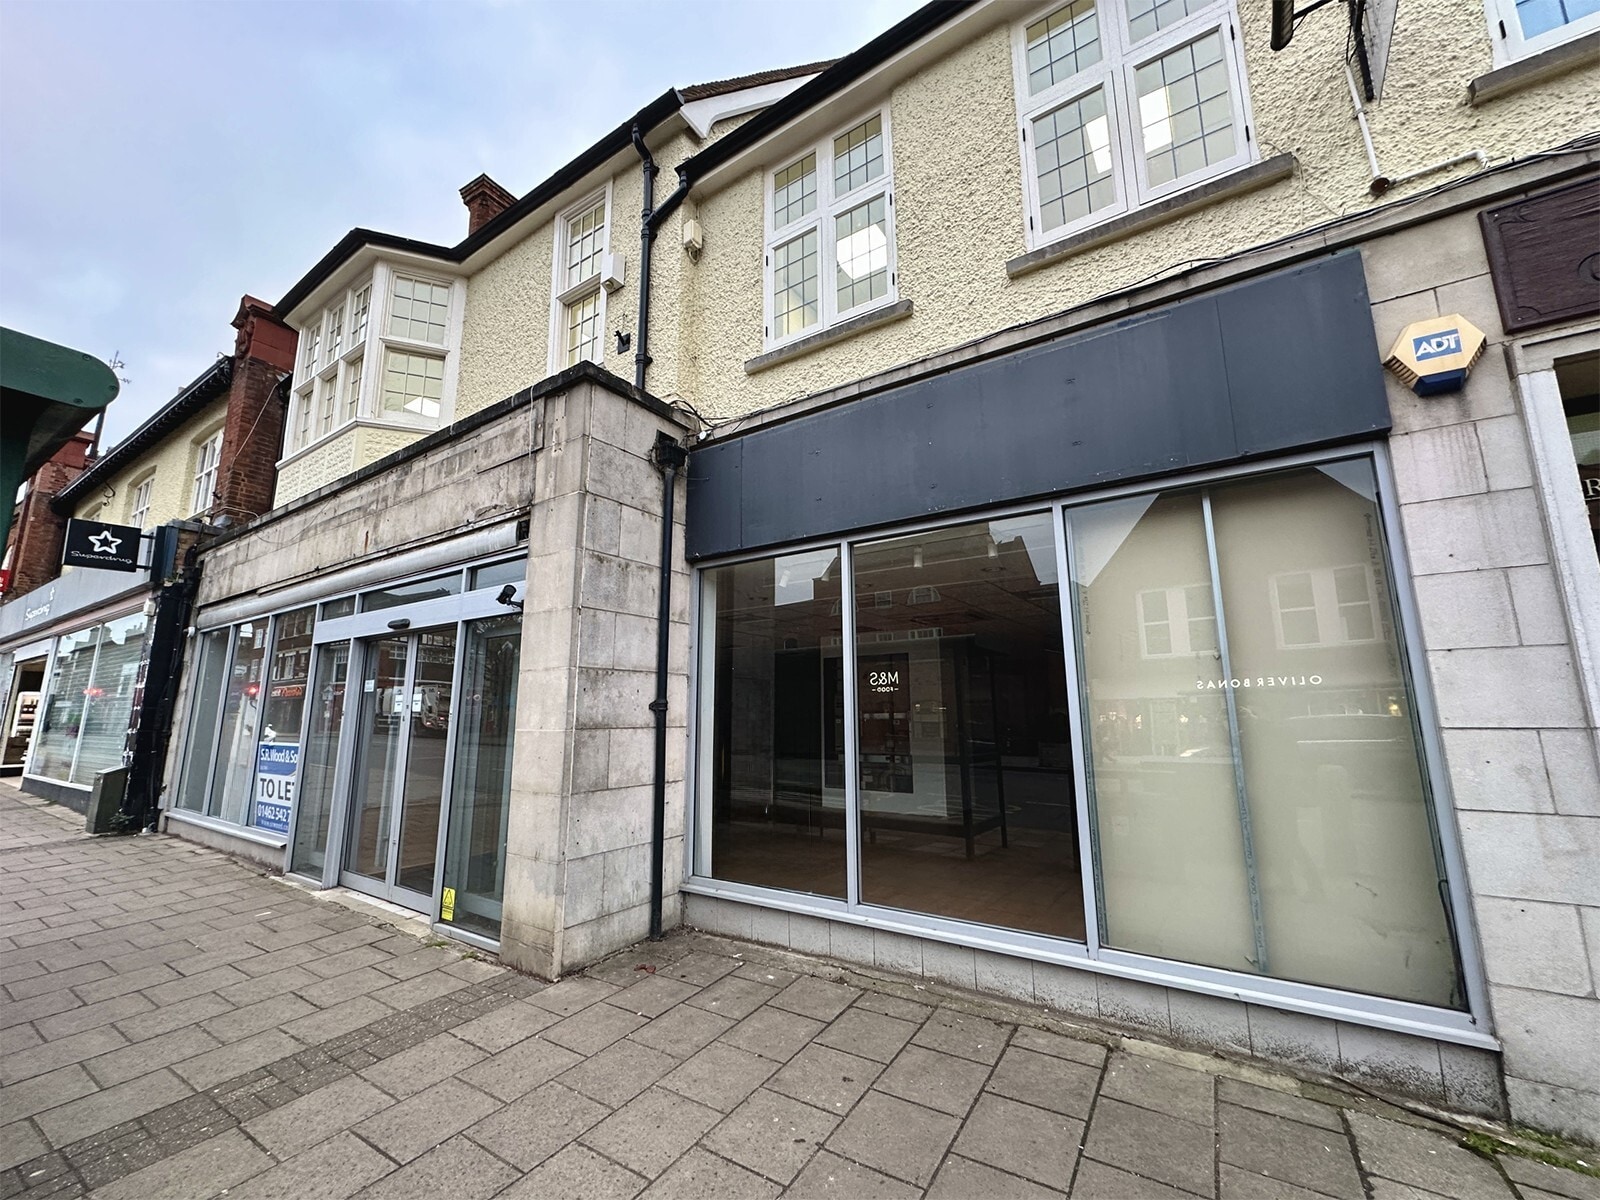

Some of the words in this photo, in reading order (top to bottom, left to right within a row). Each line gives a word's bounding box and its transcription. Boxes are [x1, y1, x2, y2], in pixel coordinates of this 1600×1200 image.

[1416, 334, 1458, 356] ADT
[71, 550, 133, 564] Superdrug
[260, 778, 275, 798] TO
[258, 804, 275, 819] 01462
[275, 807, 286, 821] 542
